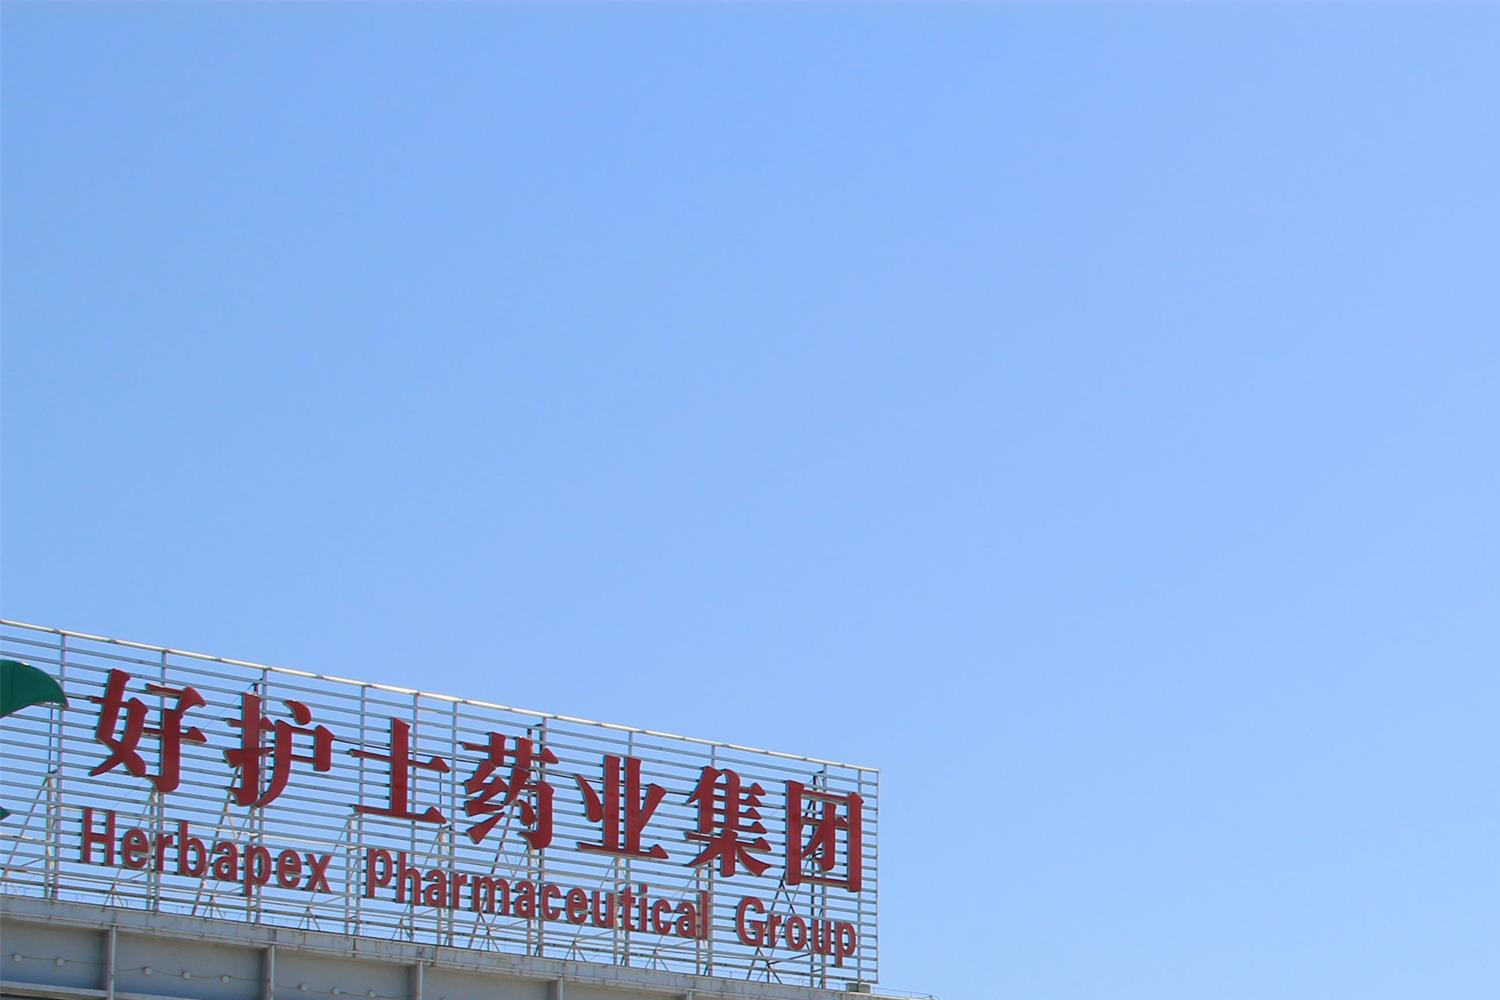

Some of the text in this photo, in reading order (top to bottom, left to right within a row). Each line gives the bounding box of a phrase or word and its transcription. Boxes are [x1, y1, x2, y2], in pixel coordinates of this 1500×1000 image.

[88, 668, 864, 893] 好护士药业集团
[80, 806, 857, 967] Herbapex Pharmaceutical Group
